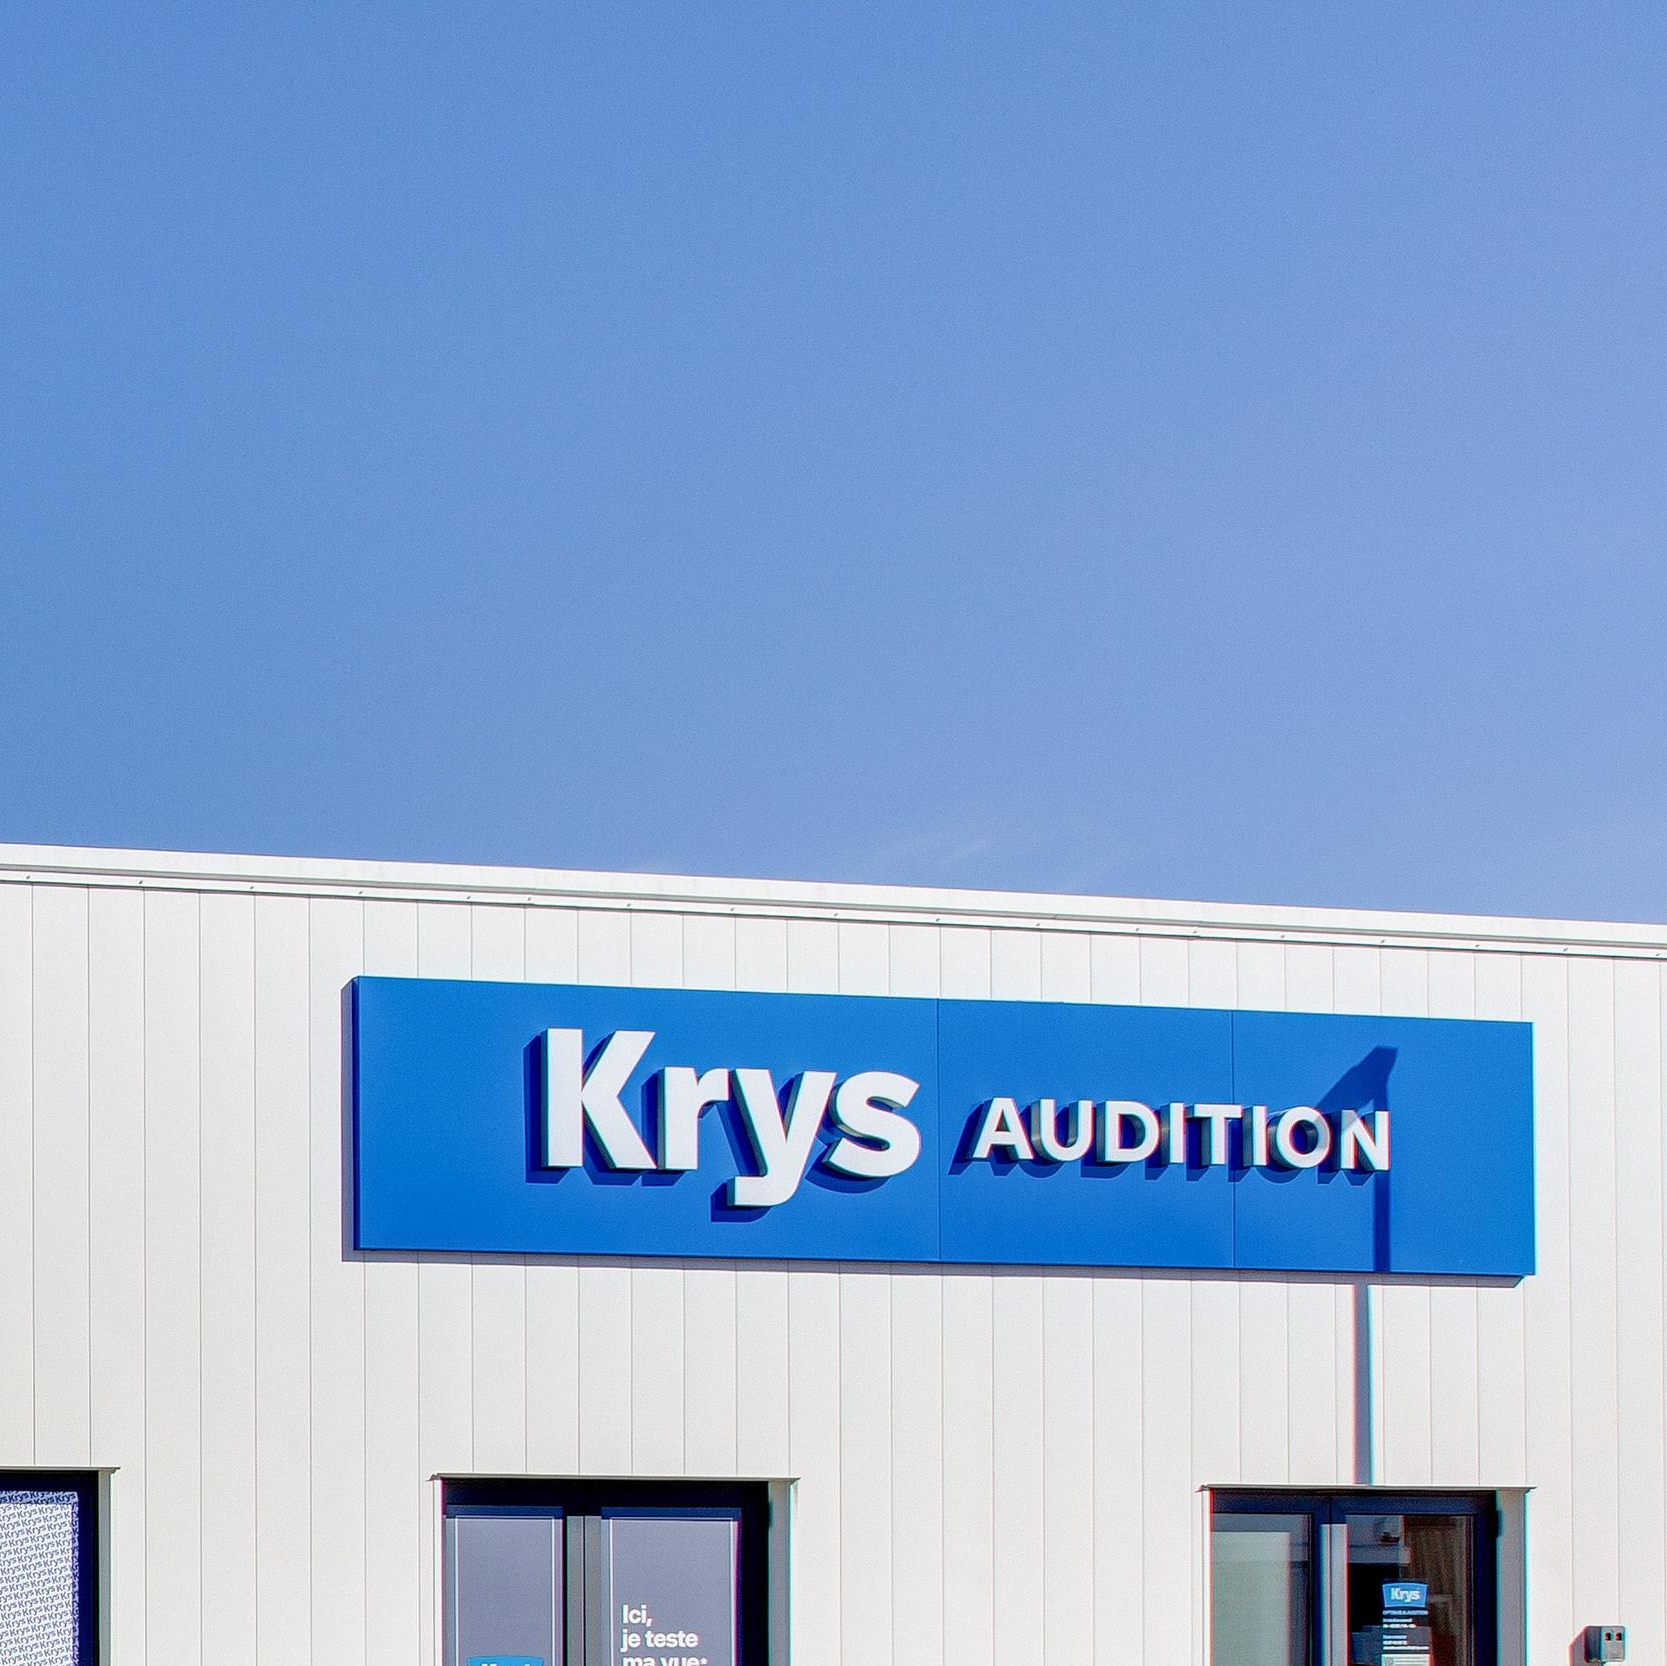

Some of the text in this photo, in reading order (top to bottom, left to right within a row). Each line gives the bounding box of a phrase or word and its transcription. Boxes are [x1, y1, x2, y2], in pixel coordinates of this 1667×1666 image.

[539, 1028, 1392, 1207] Krys AUDITION
[1390, 1587, 1421, 1603] Krys
[622, 1604, 653, 1627] Ici,
[620, 1628, 699, 1652] je teste
